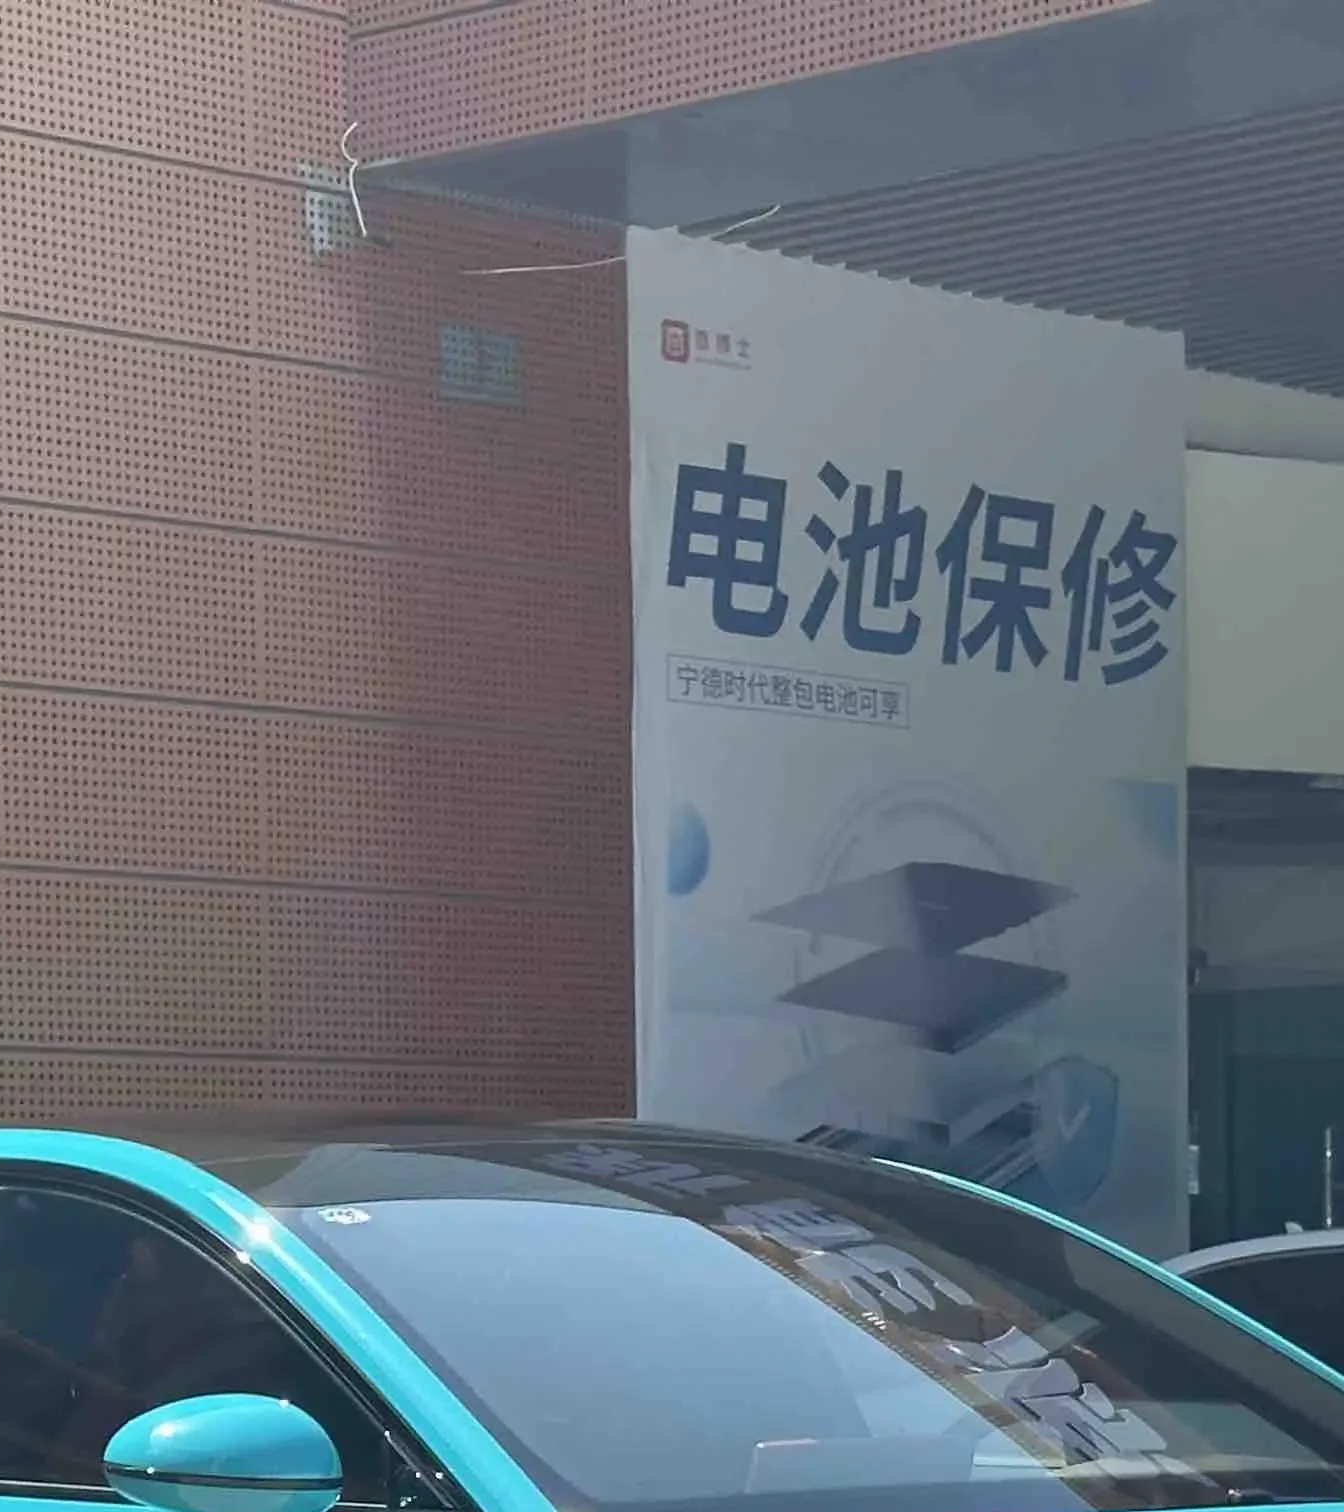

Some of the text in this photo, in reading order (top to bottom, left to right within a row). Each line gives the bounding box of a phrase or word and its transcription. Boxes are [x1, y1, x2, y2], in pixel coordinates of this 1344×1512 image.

[667, 442, 1179, 686] 电池保修
[676, 663, 901, 720] 宁德时代整包电池可享
